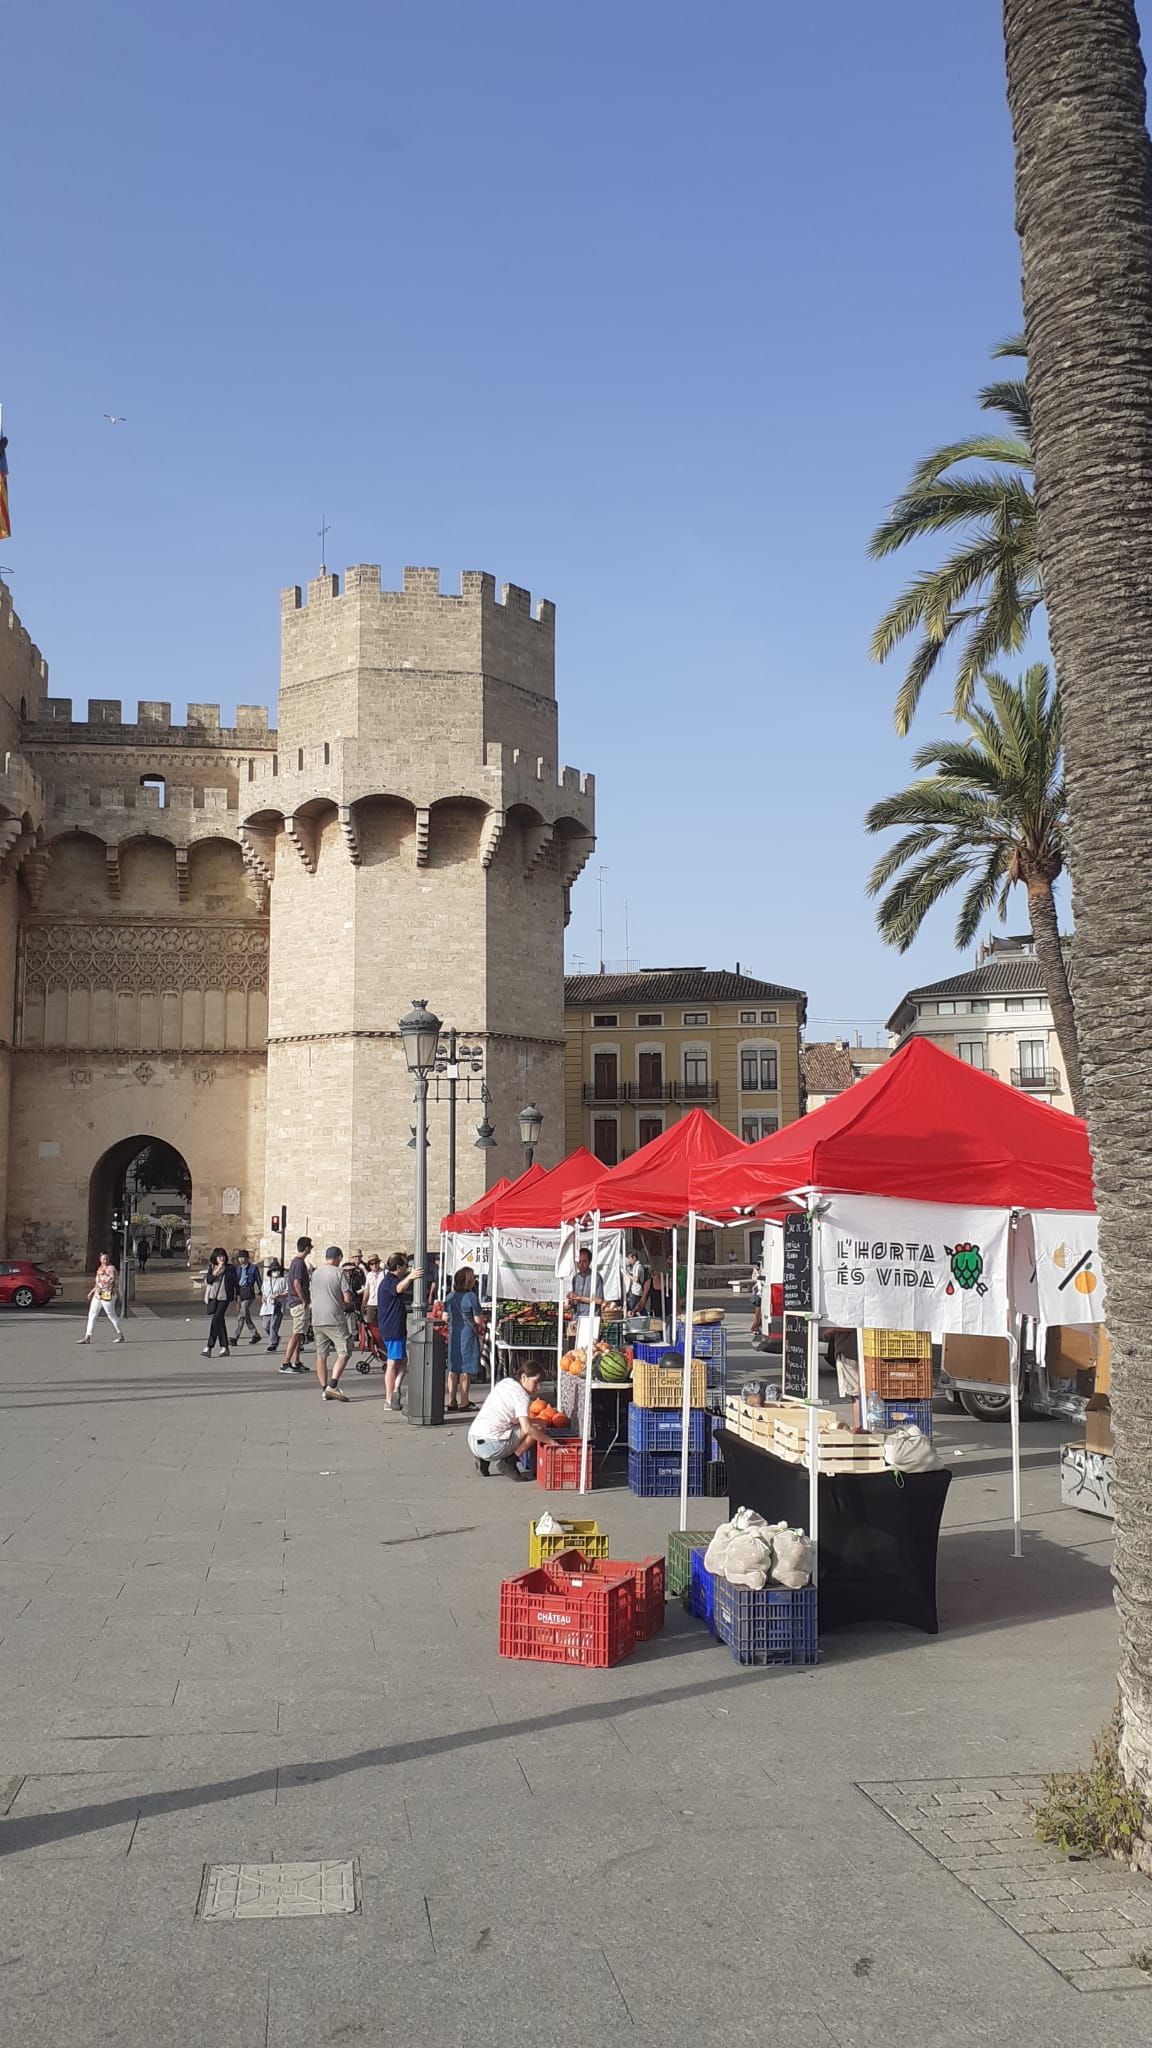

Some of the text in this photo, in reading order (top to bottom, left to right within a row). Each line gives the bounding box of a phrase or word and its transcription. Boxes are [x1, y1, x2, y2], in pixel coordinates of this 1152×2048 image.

[837, 1238, 935, 1262] L'HORTA
[837, 1262, 865, 1285] ÉS
[537, 1612, 571, 1624] CHÂTEAU
